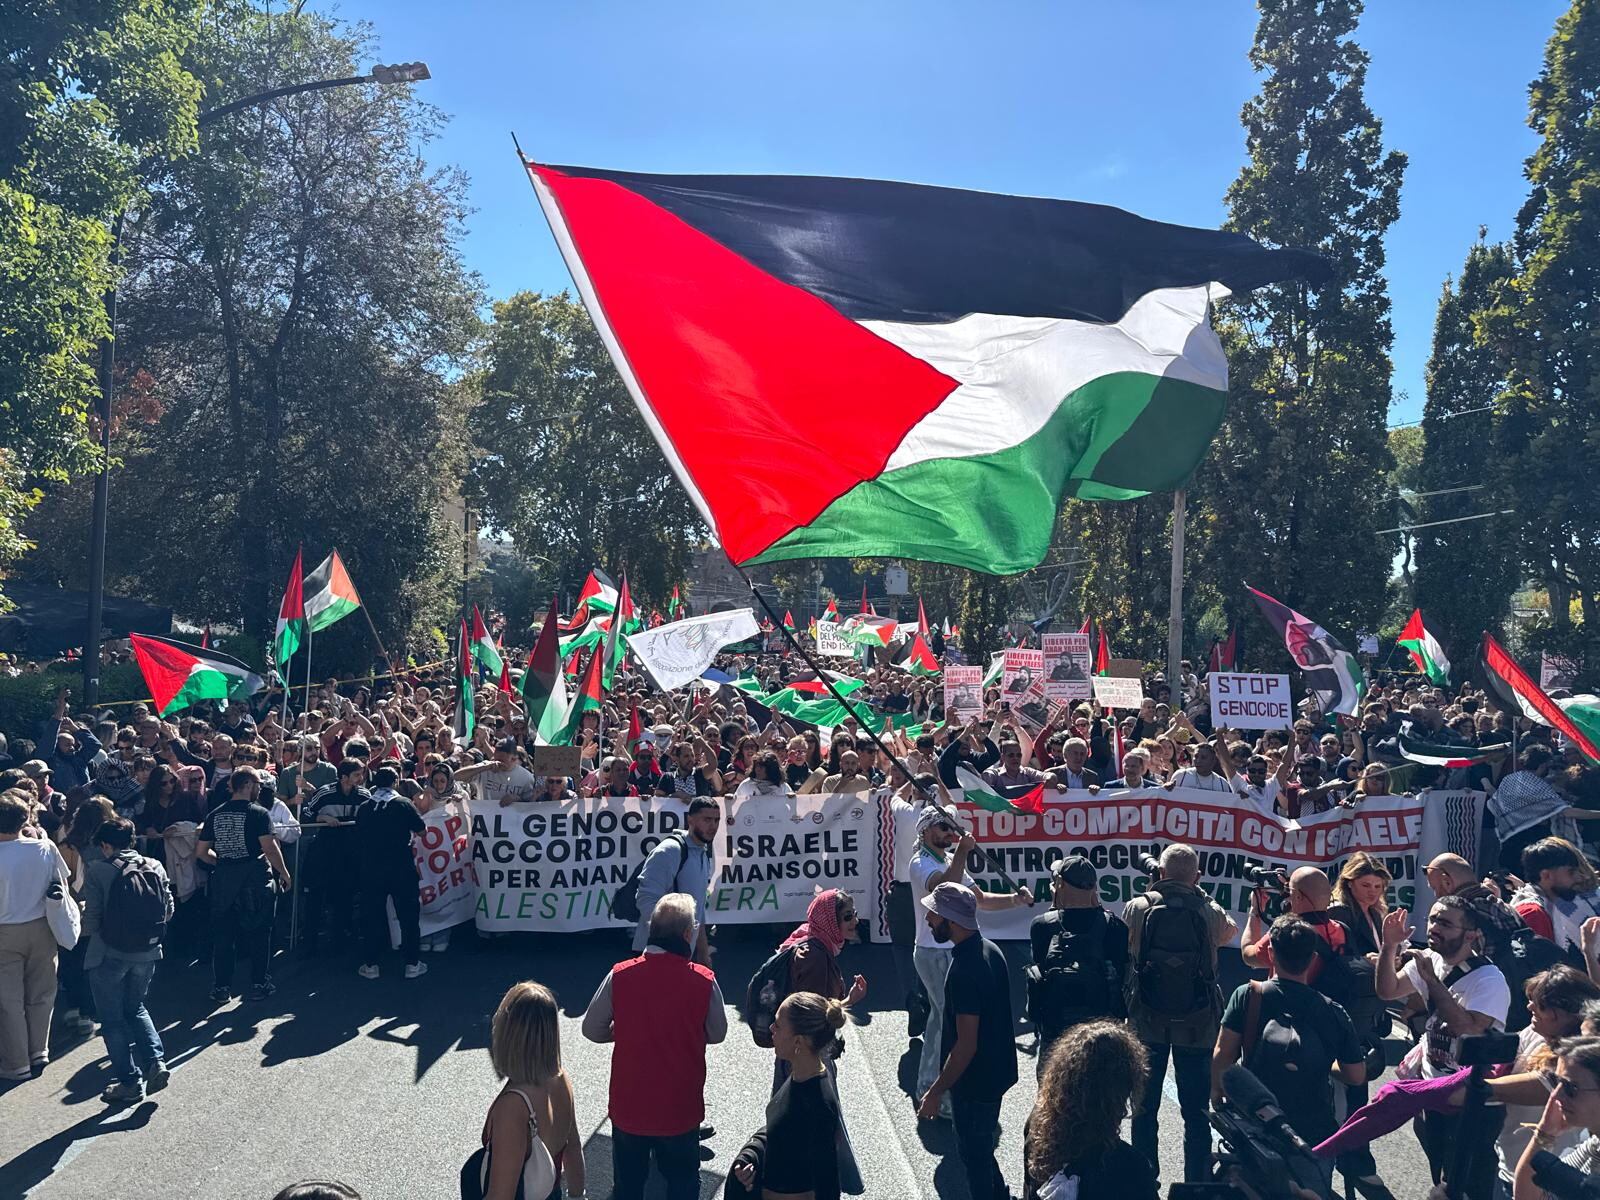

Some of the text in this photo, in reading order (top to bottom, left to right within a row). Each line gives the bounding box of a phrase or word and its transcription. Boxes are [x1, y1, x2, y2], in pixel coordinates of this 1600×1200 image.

[1217, 675, 1279, 695] STOP
[1218, 700, 1289, 718] GENOCIDE
[522, 810, 689, 838] GENOCIDI
[957, 804, 1423, 857] STOP COMPLICITÀ CON ISRAELE
[472, 836, 627, 864] ACCORDI
[726, 829, 859, 859] ISRAELE
[960, 845, 1064, 874] ONTRO
[489, 869, 541, 889] PER
[550, 864, 628, 889] ANAN
[721, 858, 859, 884] MANSOUR
[474, 888, 614, 920] ALESTIN
